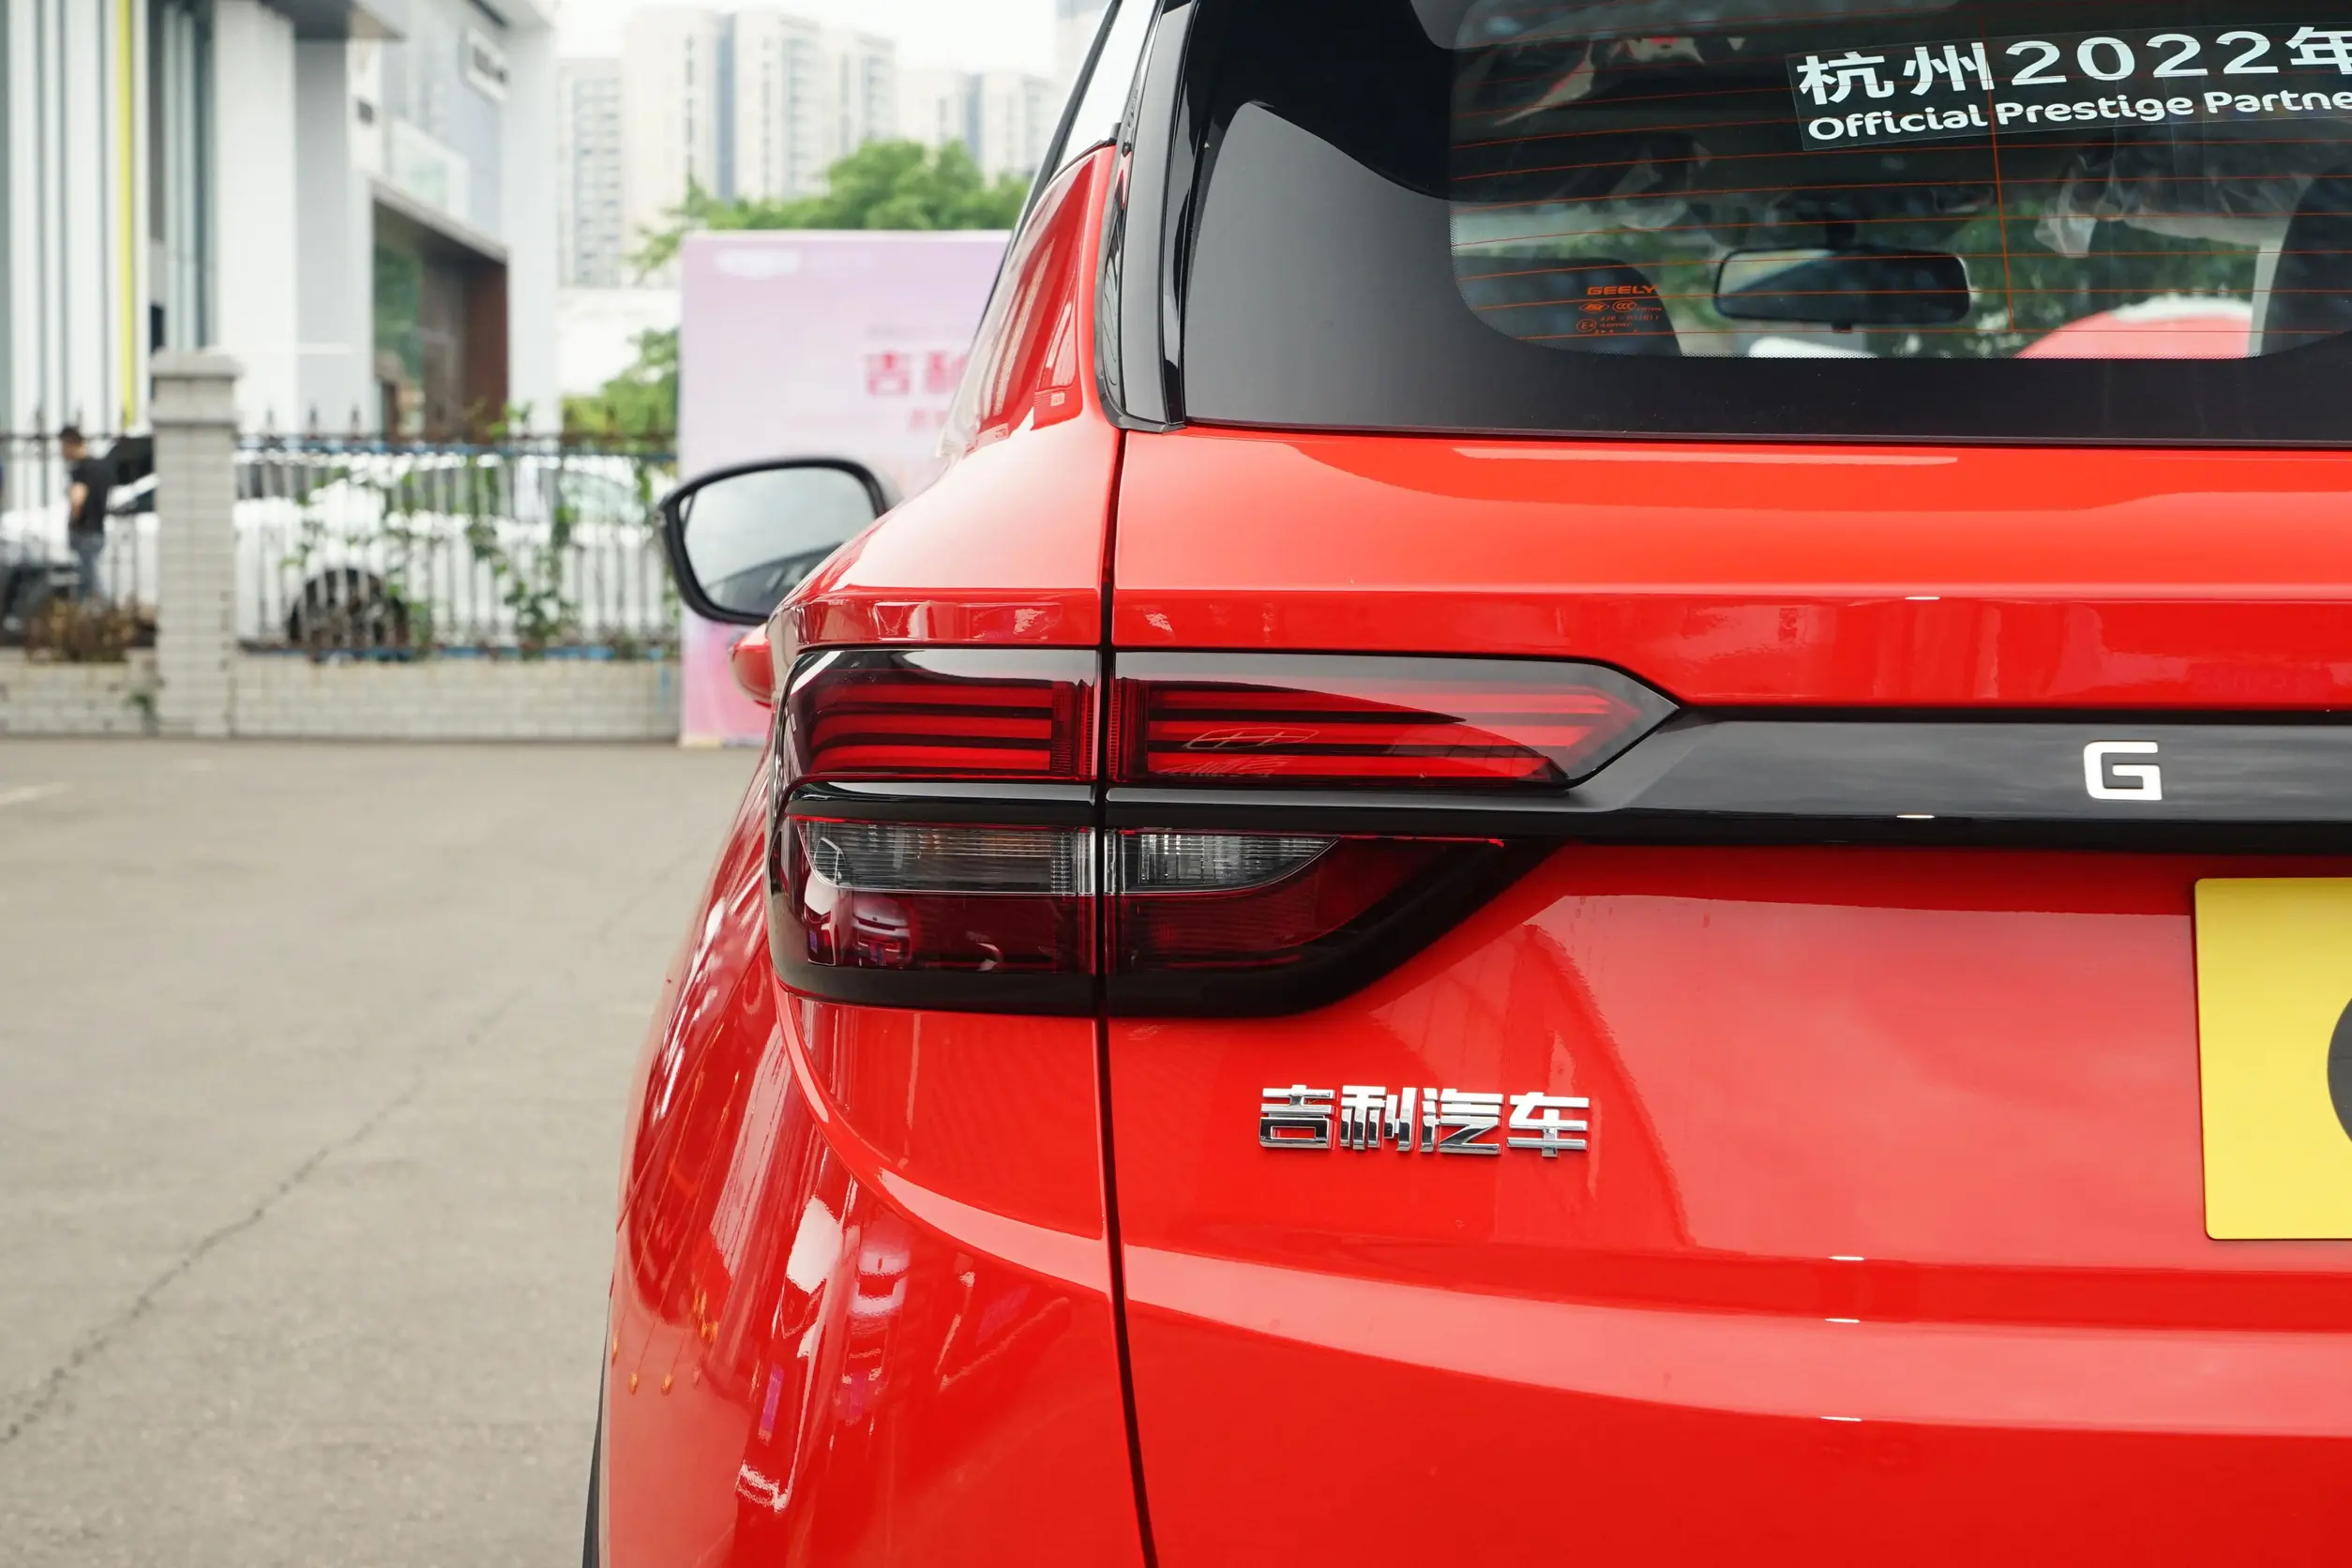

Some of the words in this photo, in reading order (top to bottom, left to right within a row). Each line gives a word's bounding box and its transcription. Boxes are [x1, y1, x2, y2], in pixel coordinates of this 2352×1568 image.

[1808, 104, 1988, 141] Official
[1997, 94, 2194, 126] Prestige
[1587, 285, 1658, 295] GEELY
[2084, 741, 2162, 800] G
[1259, 1084, 1590, 1158] 吉利汽车
